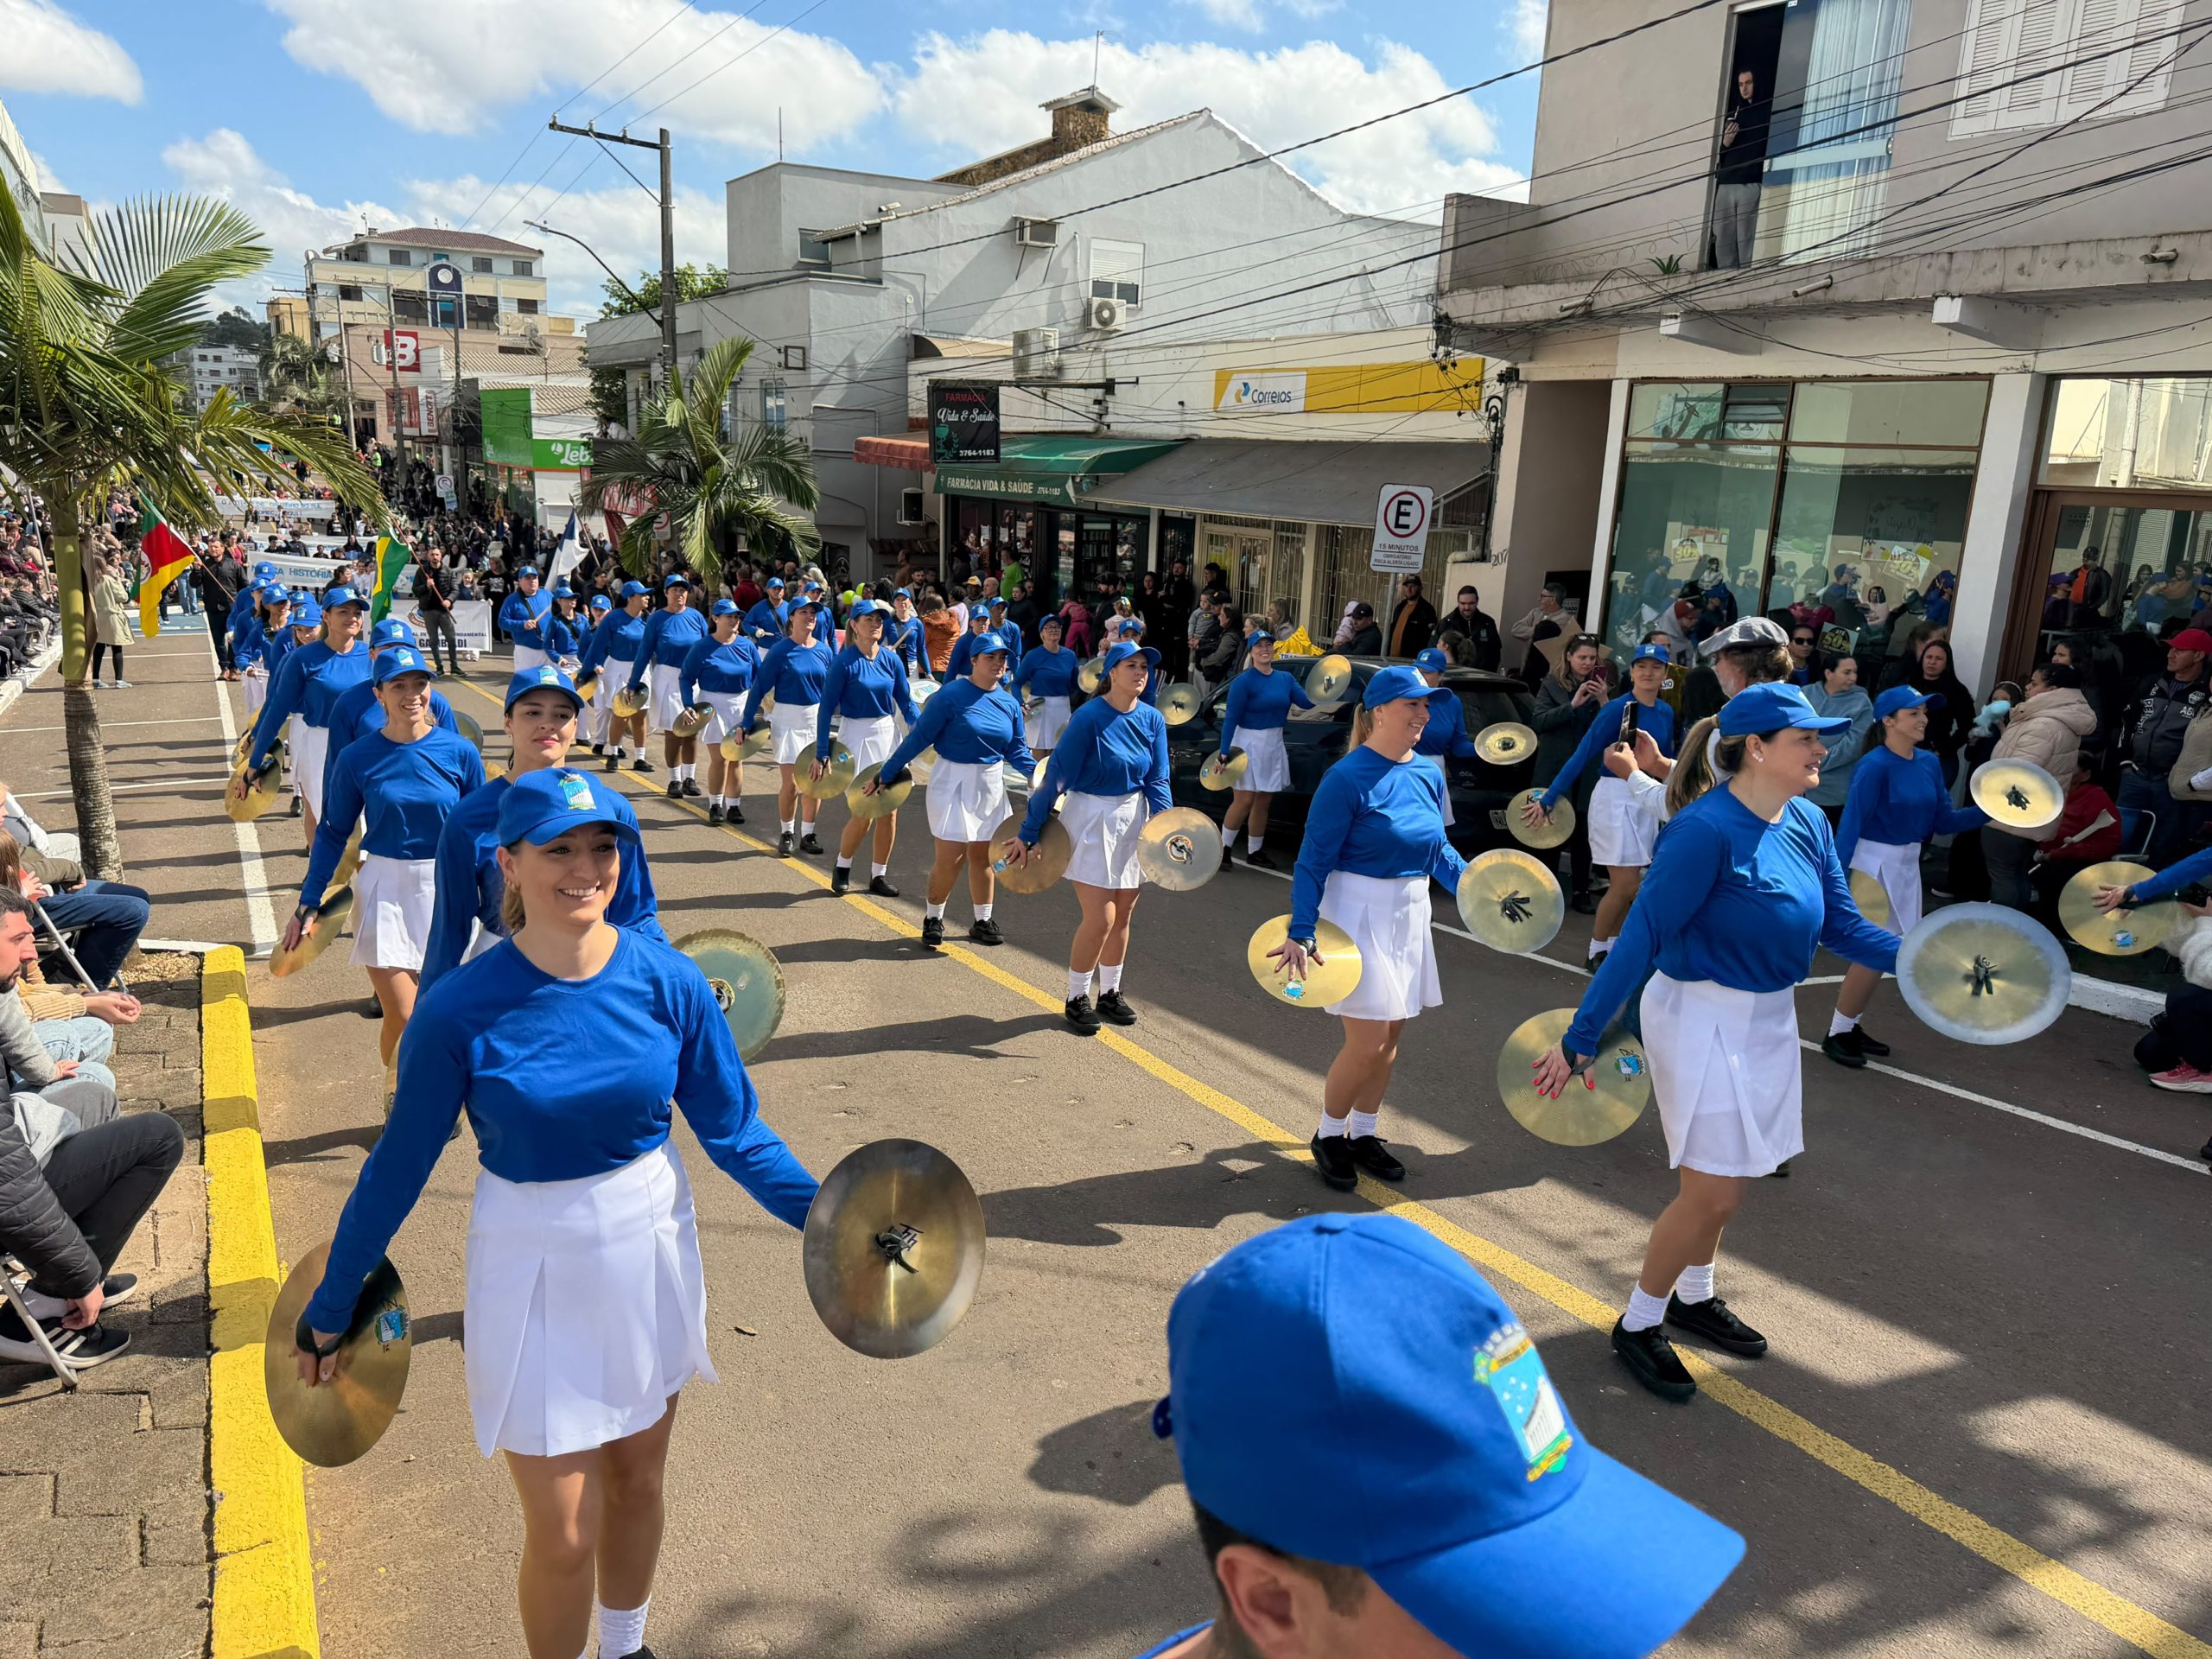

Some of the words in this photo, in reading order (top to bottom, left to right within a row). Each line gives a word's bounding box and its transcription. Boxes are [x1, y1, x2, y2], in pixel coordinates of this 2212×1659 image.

[1251, 389, 1292, 404] Correios
[937, 407, 959, 423] Vida
[960, 410, 969, 422] &
[969, 408, 995, 423] Saúde
[982, 480, 999, 491] VIDA
[1000, 480, 1006, 492] &
[1007, 479, 1033, 494] SAÚDE
[1394, 499, 1414, 530] E
[1491, 548, 1509, 567] 207
